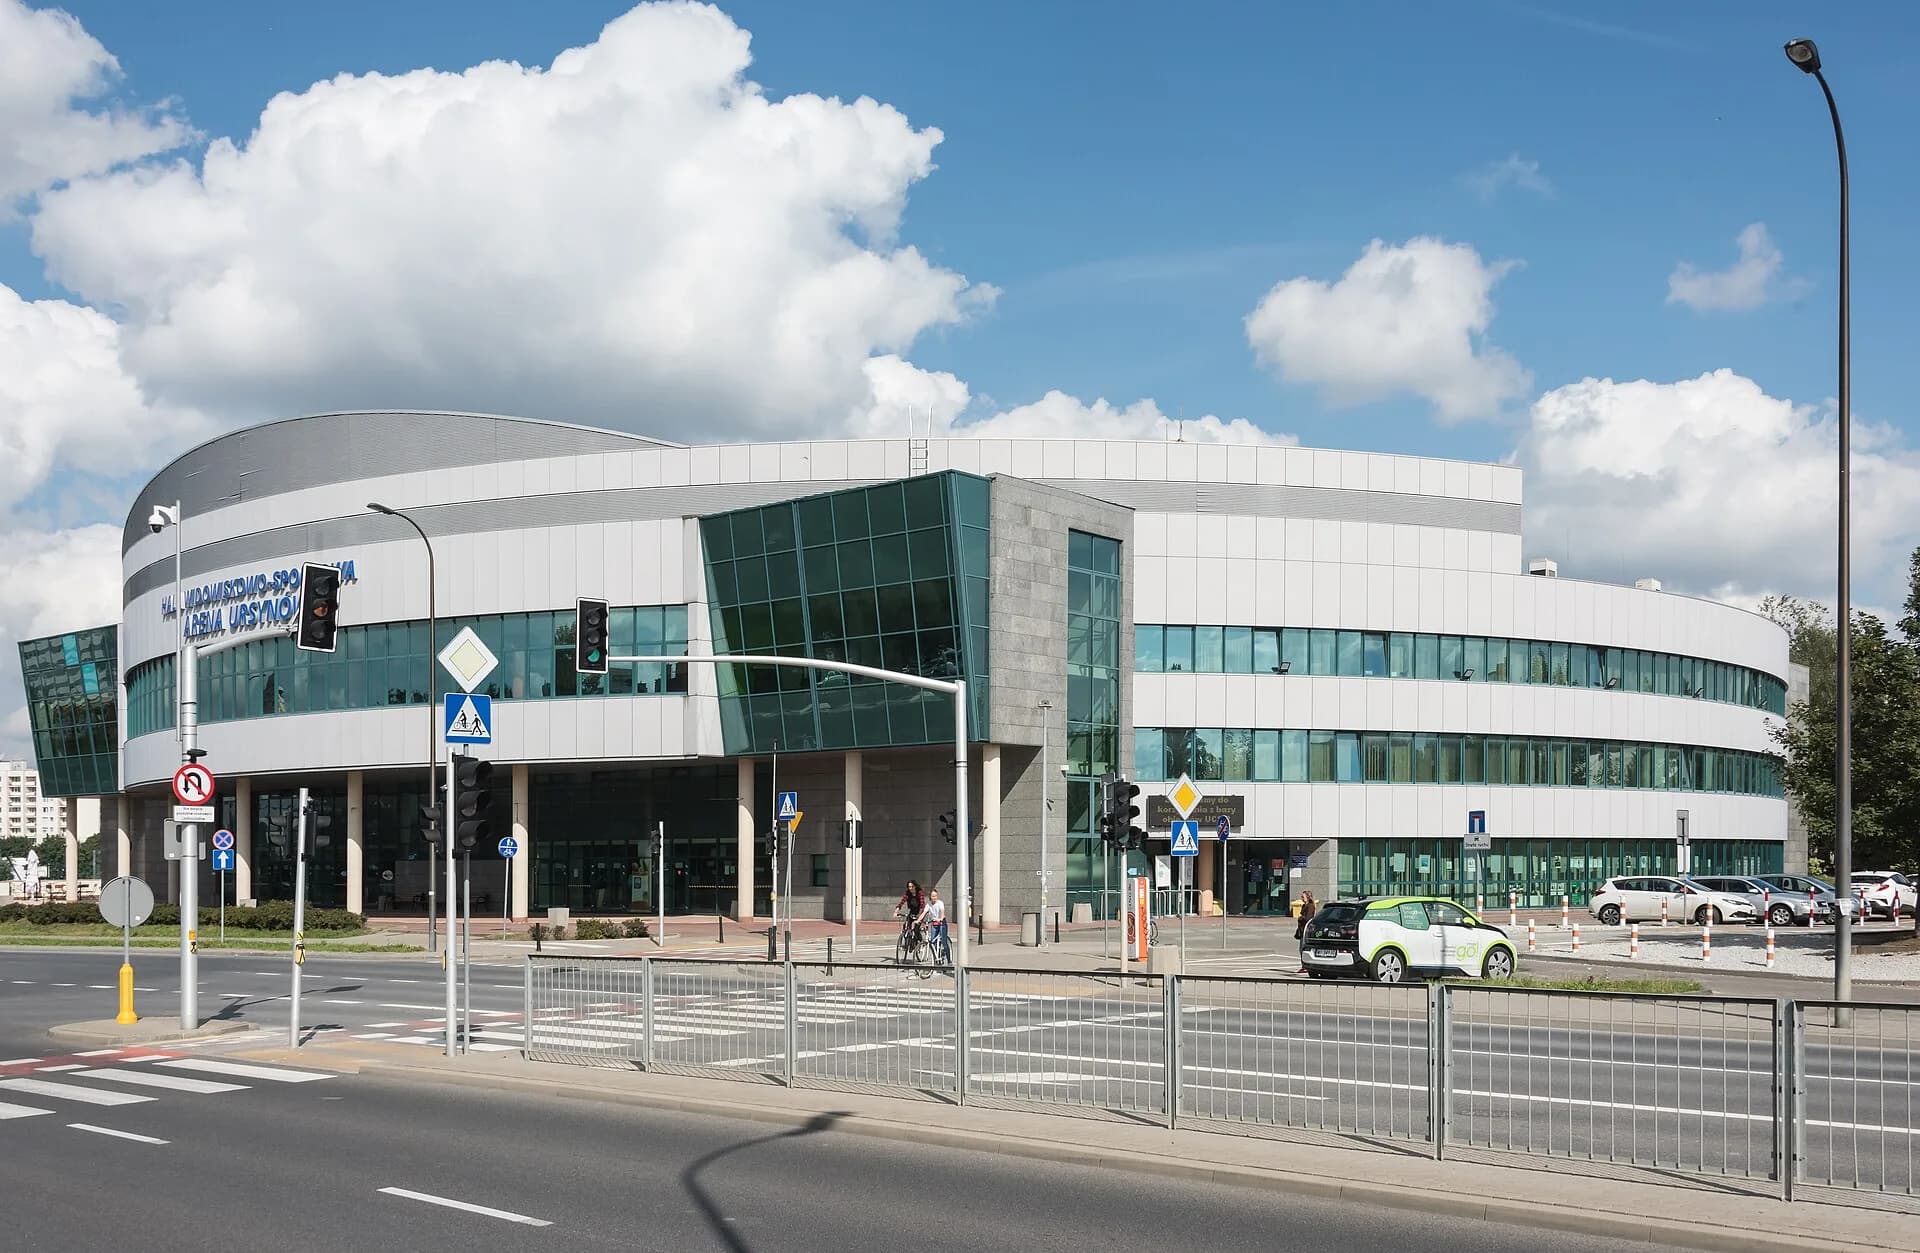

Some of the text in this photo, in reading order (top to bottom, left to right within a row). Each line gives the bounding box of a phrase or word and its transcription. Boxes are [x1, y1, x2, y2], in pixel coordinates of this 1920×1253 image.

[161, 560, 356, 615] HAL WIDOWISKOWO-SPOWA
[183, 608, 223, 637] ARENA
